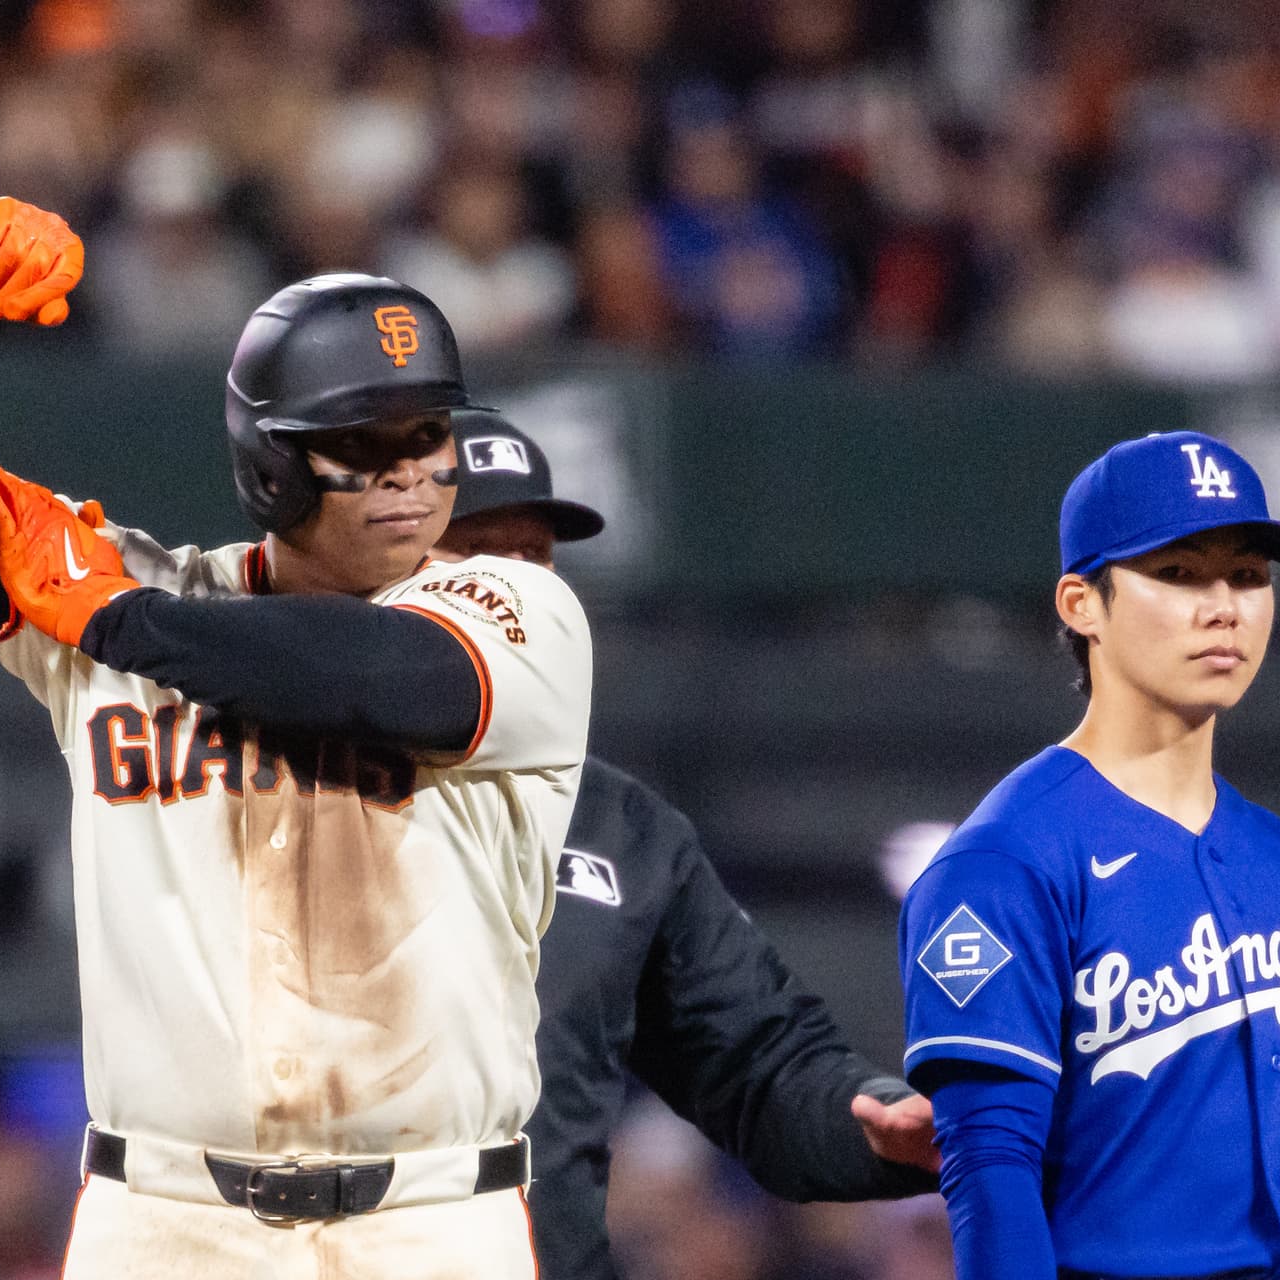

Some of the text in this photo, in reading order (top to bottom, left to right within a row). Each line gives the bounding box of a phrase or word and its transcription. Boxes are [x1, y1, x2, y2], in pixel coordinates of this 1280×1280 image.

[373, 305, 419, 367] SF
[1180, 444, 1236, 498] LA
[421, 579, 526, 645] GIANTS
[432, 592, 470, 616] EBALL
[944, 932, 982, 966] G
[1073, 952, 1186, 1054] Los
